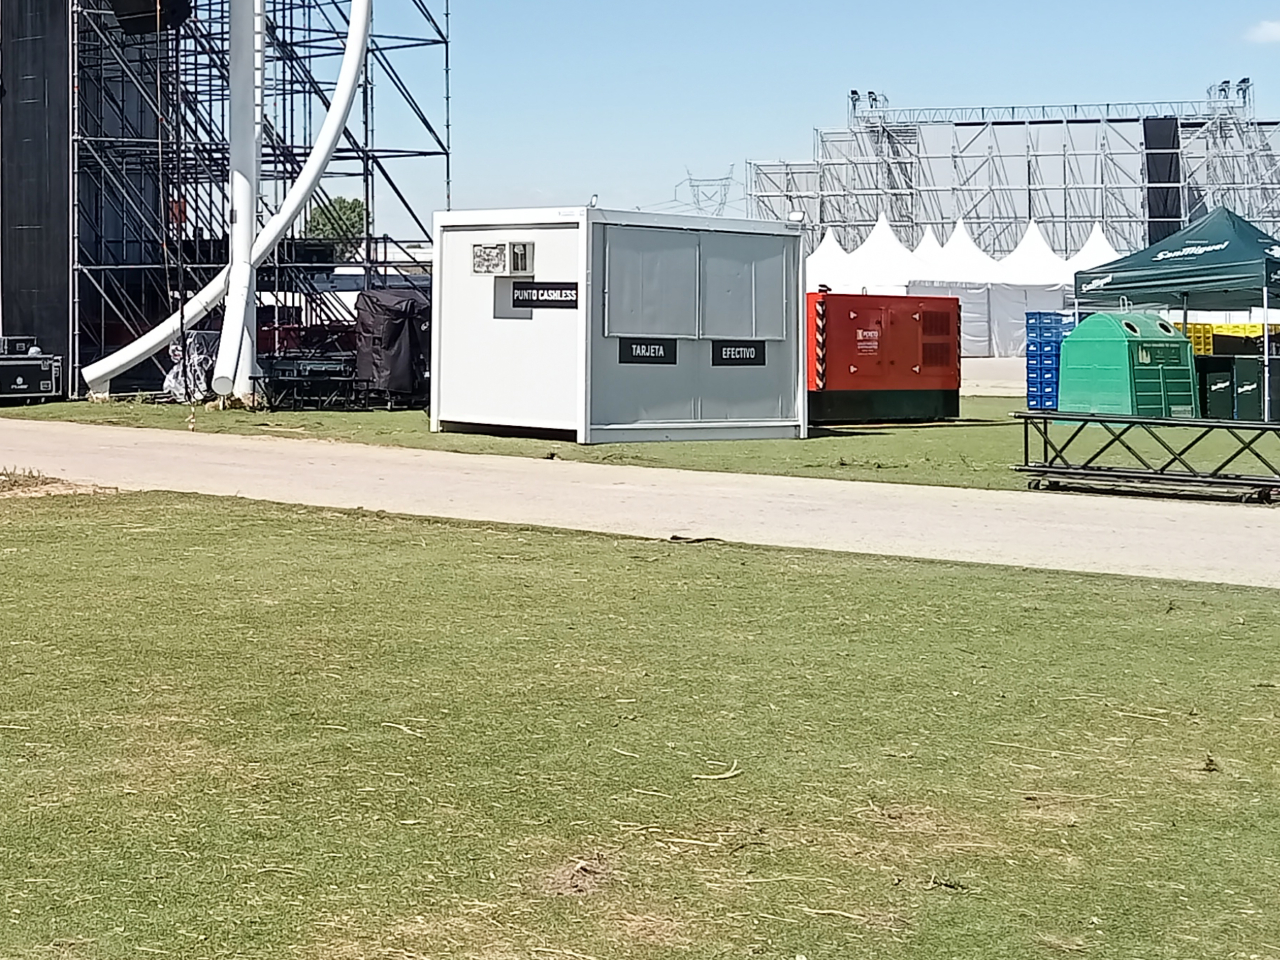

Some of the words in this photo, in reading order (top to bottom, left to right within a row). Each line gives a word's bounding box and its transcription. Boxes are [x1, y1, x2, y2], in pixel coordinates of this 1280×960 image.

[514, 289, 537, 300] PUNTO
[538, 289, 577, 301] CASHLESS
[631, 344, 665, 357] TARJETA
[722, 347, 756, 359] EFECTIVO
